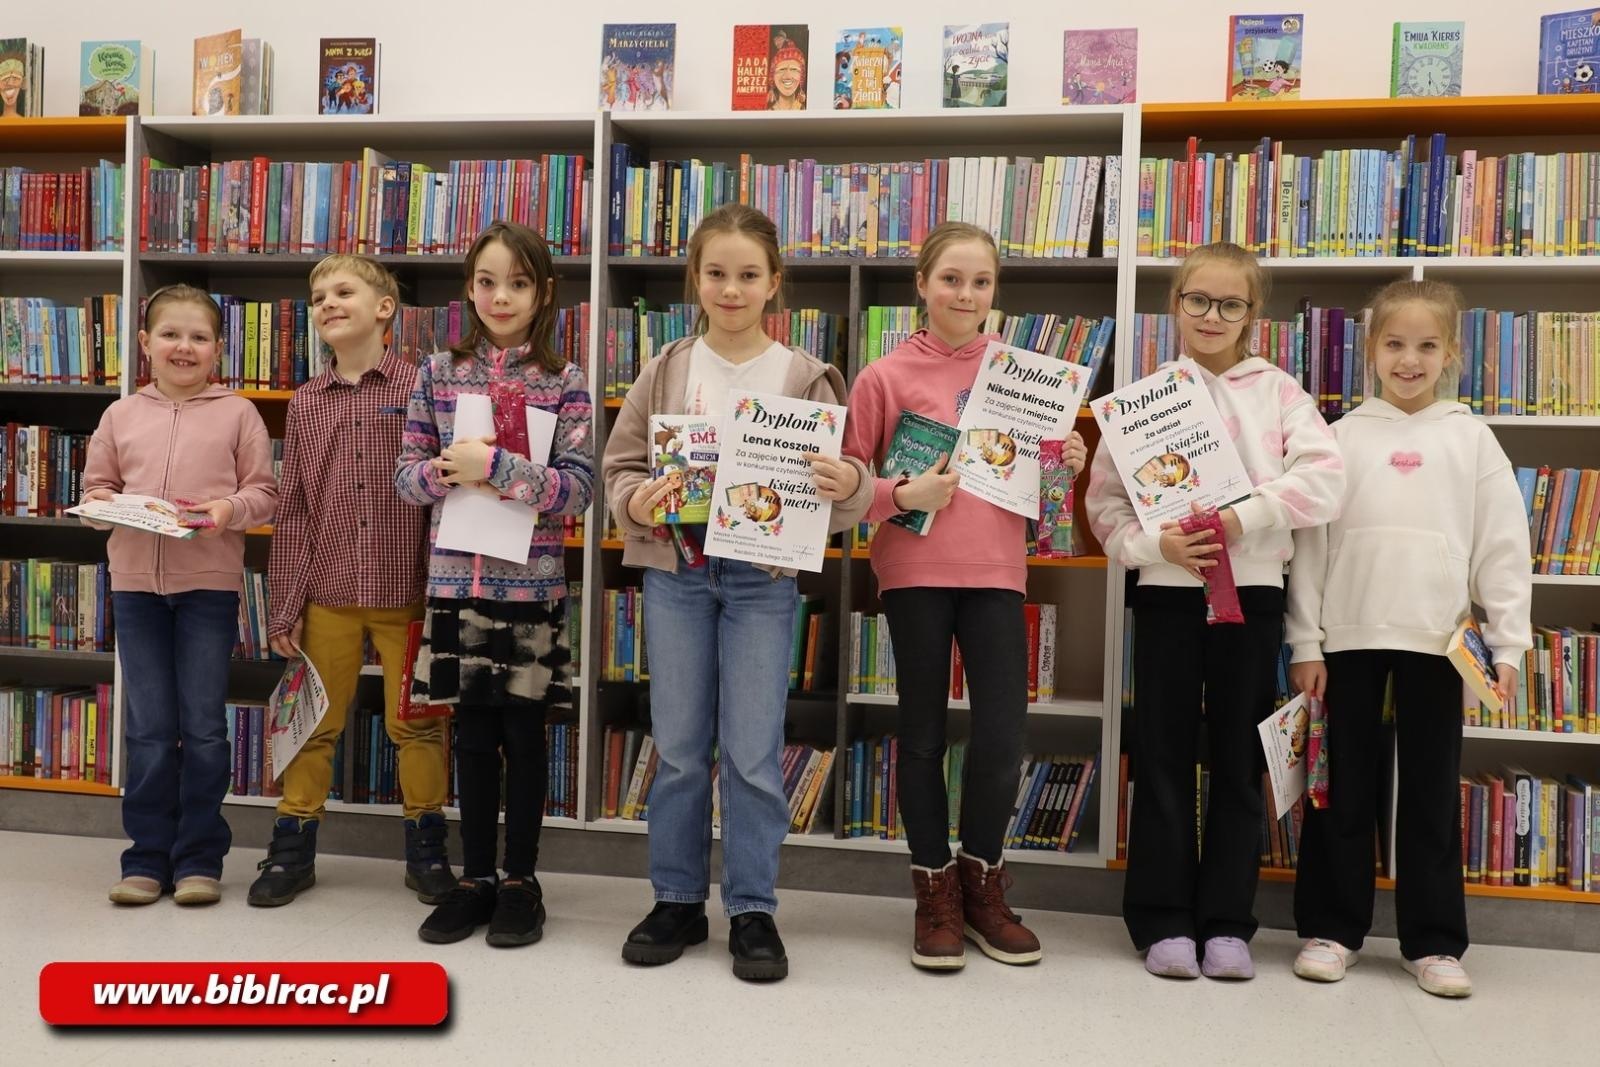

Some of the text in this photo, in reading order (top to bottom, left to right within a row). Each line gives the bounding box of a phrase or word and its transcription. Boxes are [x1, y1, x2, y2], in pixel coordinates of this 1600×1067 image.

[1431, 30, 1461, 42] KIEREŚ
[1561, 25, 1600, 40] MIESZKO
[609, 38, 669, 48] MARZYCIELKI
[1567, 38, 1593, 48] KAPITAN
[737, 66, 768, 76] HALIKI
[736, 86, 767, 94] AMERYKI
[737, 77, 767, 86] PRZEZ
[1003, 358, 1063, 389] Dyplom
[987, 382, 1065, 412] Nikola Mirecka
[1118, 382, 1178, 416] Dyplom
[751, 408, 818, 433] Dyplom
[985, 397, 995, 405] Za
[996, 400, 1022, 414] zajęcie
[1027, 408, 1058, 424] miejsca
[989, 409, 1016, 422] konkursie
[1016, 416, 1054, 432] czytelniczym
[1121, 399, 1193, 436] Zofia Gonsior
[689, 431, 717, 444] EMI
[1145, 420, 1181, 440] Za udział
[1165, 420, 1205, 443] czytelniczym
[743, 433, 820, 454] Lena Koszela
[1166, 428, 1210, 454] Książka
[1187, 438, 1220, 460] metry
[735, 448, 812, 468] Za zajęcie V miejs
[743, 461, 775, 472] konkursie
[768, 478, 817, 496] Książka
[783, 496, 820, 513] metry
